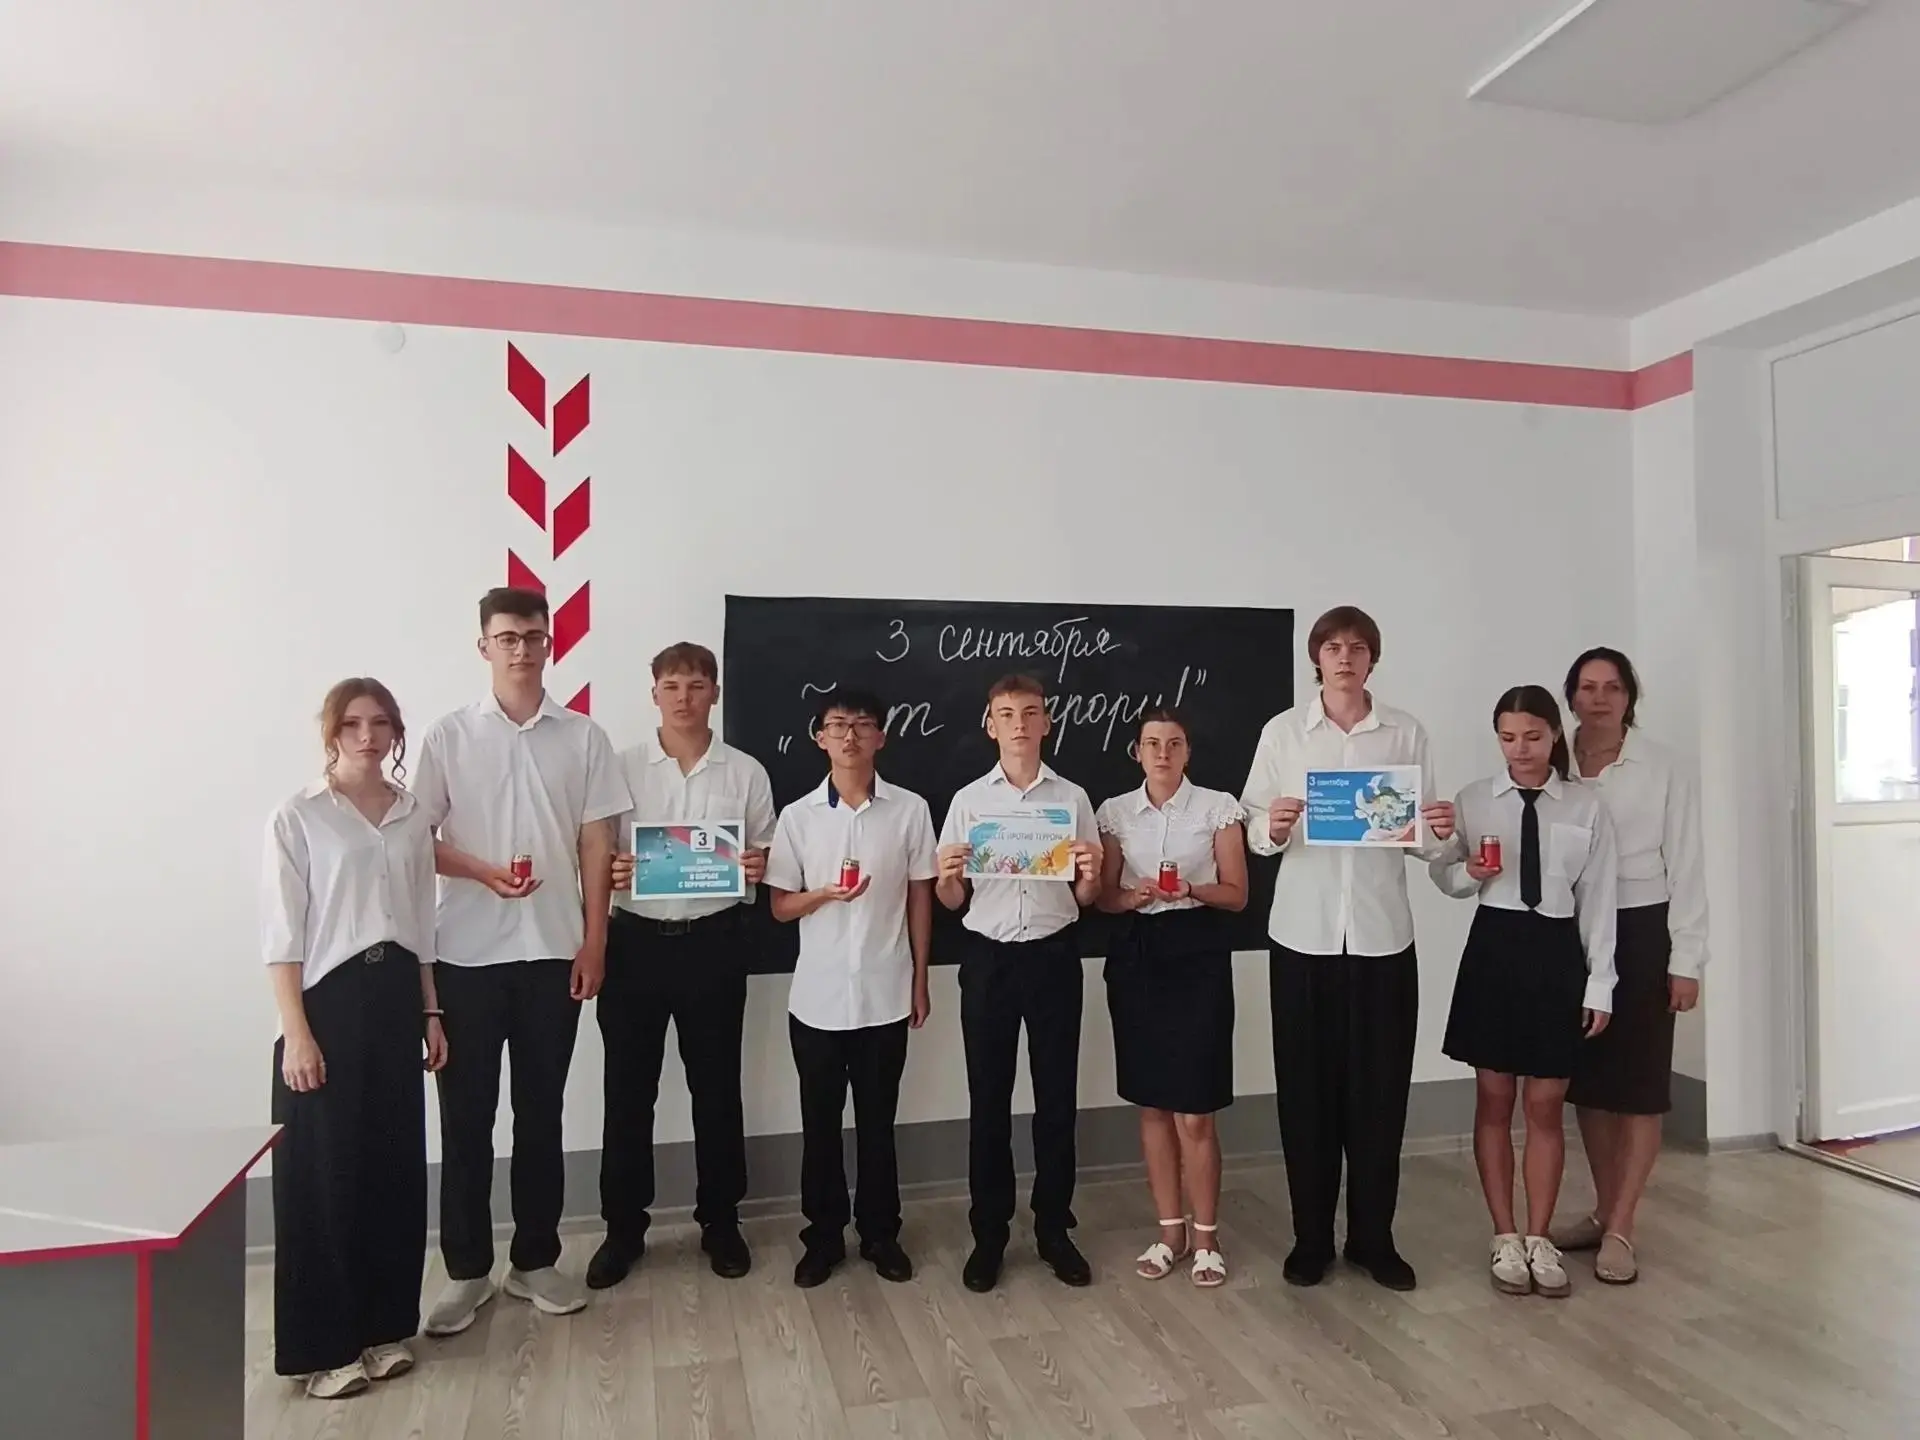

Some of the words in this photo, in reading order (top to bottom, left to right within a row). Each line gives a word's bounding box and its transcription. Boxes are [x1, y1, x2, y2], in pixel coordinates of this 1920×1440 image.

[877, 619, 910, 662] 3
[1309, 776, 1316, 786] 3
[698, 832, 707, 846] 3
